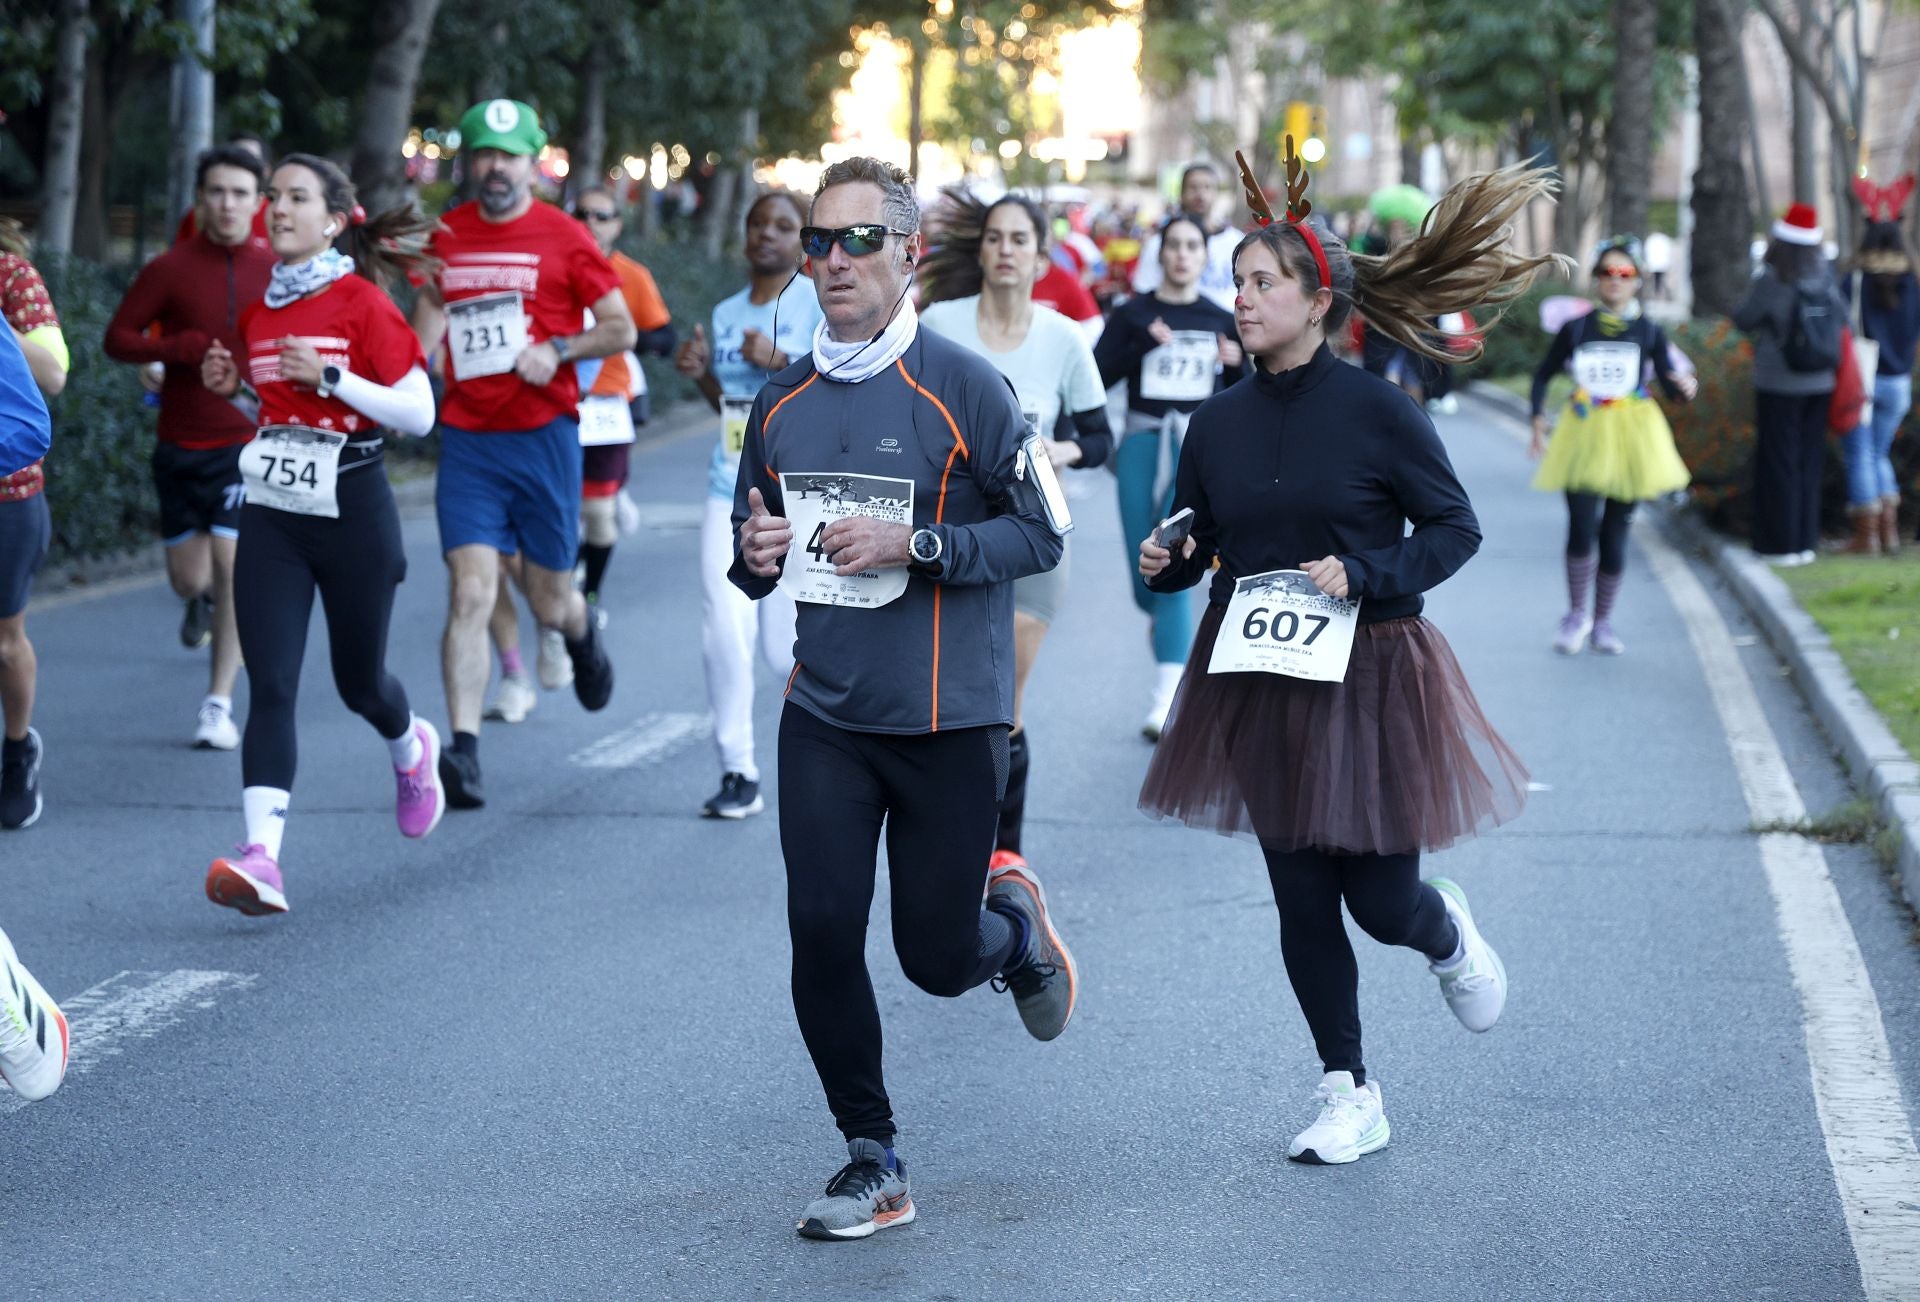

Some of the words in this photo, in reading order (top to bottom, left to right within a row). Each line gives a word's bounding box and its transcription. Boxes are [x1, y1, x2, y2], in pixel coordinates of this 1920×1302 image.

[497, 106, 510, 124] L
[463, 325, 507, 354] 231
[1158, 356, 1203, 379] 873
[260, 455, 318, 489] 754
[858, 504, 905, 512] CARRERA
[865, 496, 909, 507] XIV
[855, 508, 905, 517] SILVESTRE
[1301, 603, 1351, 616] PALMILLA
[1243, 607, 1330, 646] 607
